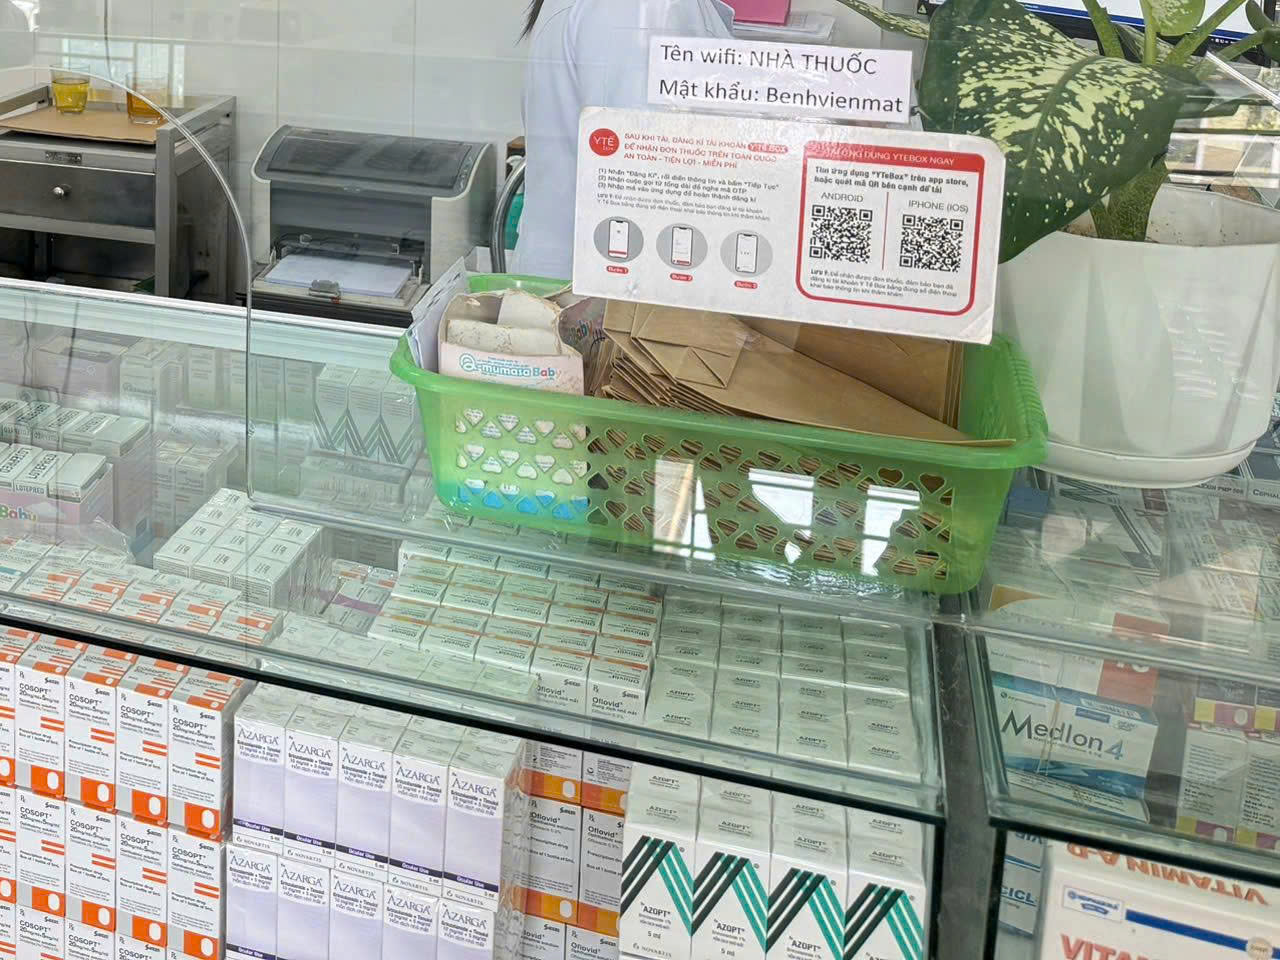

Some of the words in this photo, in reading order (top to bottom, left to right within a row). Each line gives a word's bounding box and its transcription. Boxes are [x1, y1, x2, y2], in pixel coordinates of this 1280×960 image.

[660, 44, 693, 63] Tên
[699, 48, 743, 66] wifi:
[749, 49, 795, 70] NHÀ
[800, 51, 878, 75] THUỐC
[659, 79, 698, 99] Mật
[705, 81, 760, 102] khẩu:
[766, 87, 903, 113] Benhvienmat
[892, 152, 928, 164] YTEBOX
[930, 157, 955, 165] NGAY
[929, 176, 943, 185] app
[820, 192, 864, 202] ANDROID
[908, 200, 944, 210] IPHONE
[947, 202, 969, 213] (IOS)
[19, 682, 51, 695] COSOPT
[69, 693, 102, 706] COSOPT
[120, 705, 154, 717] COSOPT
[172, 717, 207, 730] COSOPT
[238, 728, 279, 746] AZARGA
[1001, 709, 1103, 753] Medlon
[1104, 740, 1124, 761] 4
[289, 741, 331, 760] AZARGA
[342, 752, 385, 772] AZARGA
[395, 766, 440, 786] AZARGA
[451, 777, 497, 798] AZARGA
[20, 806, 52, 819] COSOPT
[69, 819, 103, 833] COSOPT
[120, 833, 154, 846] COSOPT
[172, 846, 207, 861] COSOPT
[229, 855, 270, 874] AZARGA
[280, 868, 323, 888] AZARGA
[334, 879, 376, 900] AZARGA
[387, 894, 431, 916] AZARGA
[642, 906, 671, 917] AZOPT
[441, 908, 487, 930] AZARGA
[716, 922, 745, 934] AZOPT
[792, 939, 822, 952] AZOPT
